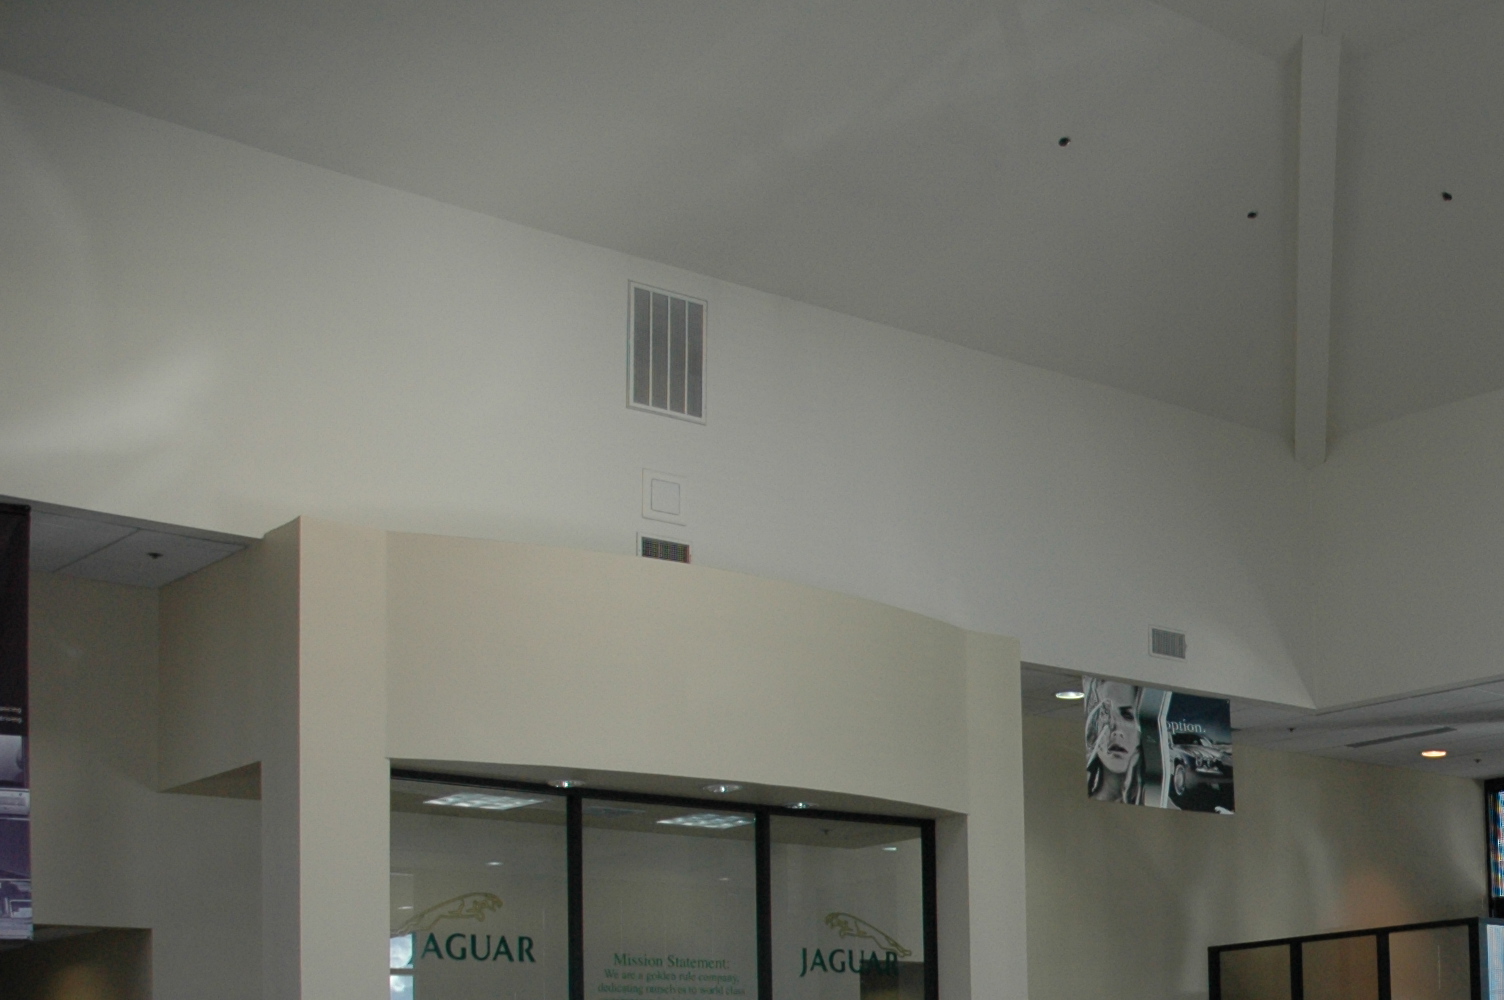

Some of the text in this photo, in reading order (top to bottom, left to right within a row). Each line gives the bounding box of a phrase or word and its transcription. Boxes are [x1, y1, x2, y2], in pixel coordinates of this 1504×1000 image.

[406, 931, 536, 967] JAGUAR
[613, 953, 730, 969] Mission Statement:
[799, 948, 899, 977] JAGUAR
[604, 968, 619, 979] We
[621, 972, 635, 980] are
[646, 971, 677, 983] golden
[679, 971, 695, 981] rule
[597, 983, 746, 996] dedicating ourselves to world class
